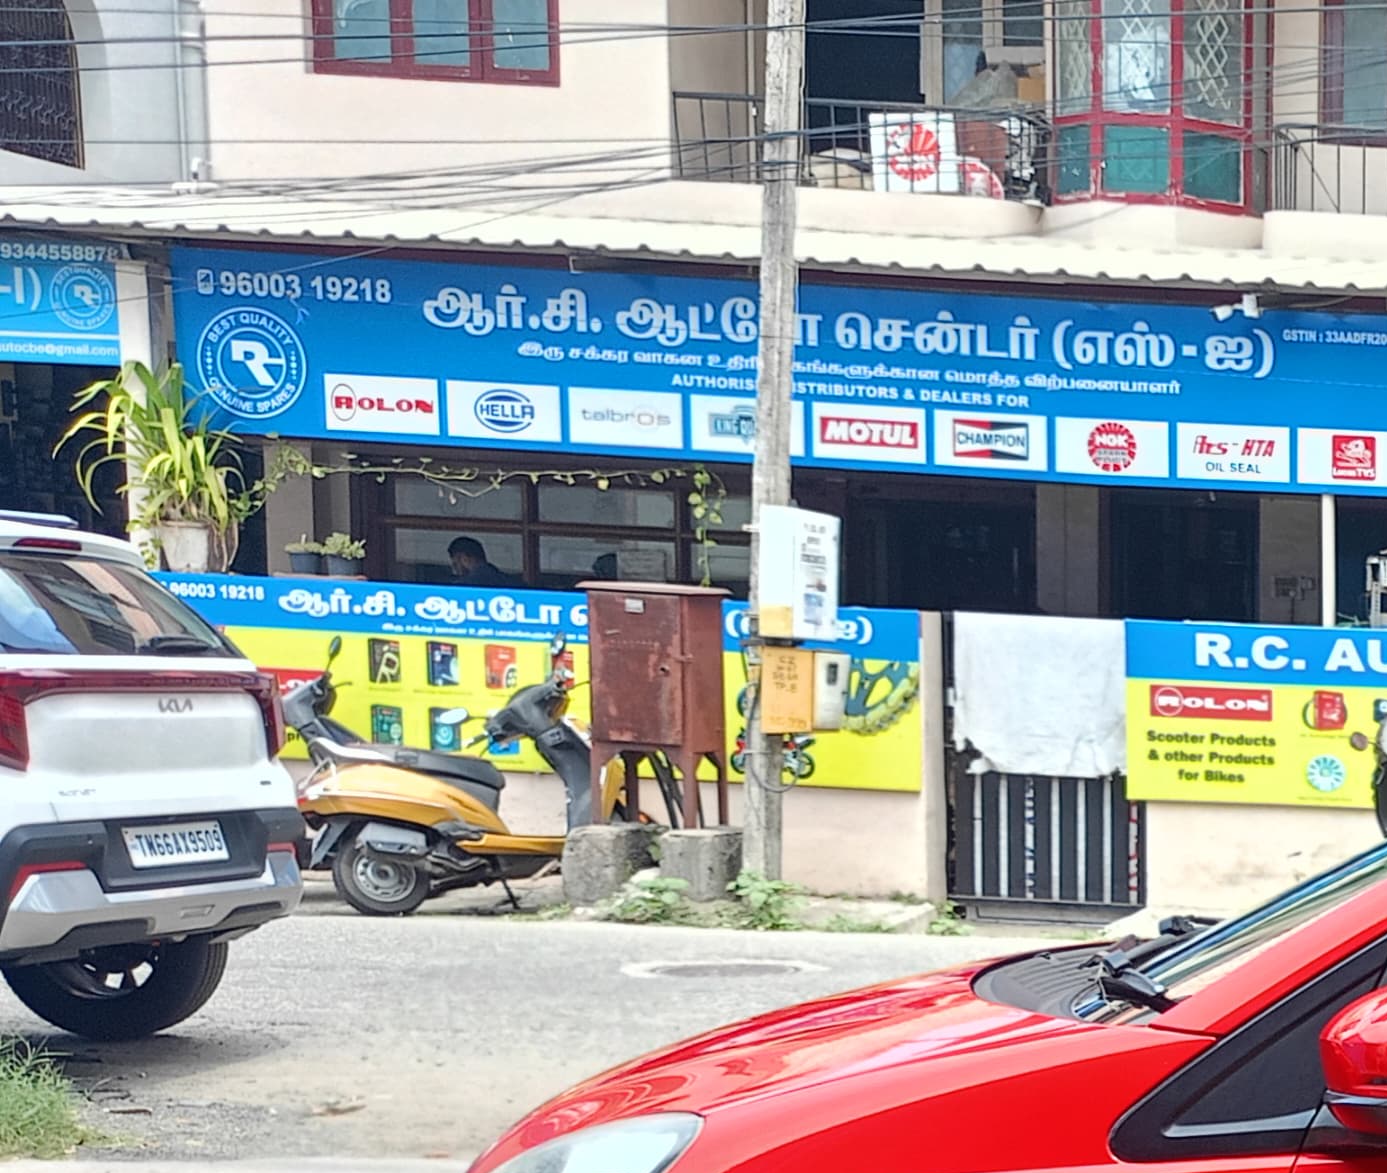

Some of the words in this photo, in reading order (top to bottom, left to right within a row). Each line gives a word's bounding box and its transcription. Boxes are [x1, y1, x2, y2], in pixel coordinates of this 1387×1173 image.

[220, 271, 302, 299] 96003
[311, 275, 392, 304] 19218
[207, 314, 237, 343] BEST
[239, 312, 293, 347] QUALITY
[423, 284, 603, 336] ஆர்.சி.
[834, 310, 1040, 361] சென்டர்
[1282, 328, 1317, 342] GSTIN
[0, 341, 119, 357] utocbe@gmail.com
[517, 341, 565, 361] இரு
[568, 345, 628, 364] சக்கர
[633, 350, 702, 367] வாகன
[210, 377, 254, 413] GENUINE
[256, 383, 296, 413] SPARES
[671, 373, 758, 392] AUTHORIS
[791, 380, 898, 400] ISTRIBUTORS
[903, 387, 916, 401] &
[919, 389, 993, 406] DEALERS
[996, 394, 1029, 409] FOR
[333, 396, 434, 415] ROLON
[479, 403, 536, 421] HELLA
[824, 420, 916, 446] MOTUL
[956, 430, 1027, 449] CHAMPION
[1095, 433, 1129, 448] NGK
[1205, 461, 1224, 472] OIL
[1229, 462, 1262, 474] SEAL
[169, 582, 216, 598] 96003
[219, 584, 265, 601] 19218
[278, 587, 406, 618] ஆர்.சி.
[414, 595, 562, 625] ஆட்டோ
[1194, 632, 1307, 671] R.C.
[1156, 694, 1269, 712] ROLON
[1147, 730, 1205, 745] Scooter
[1210, 733, 1276, 748] Products
[1148, 750, 1160, 761] &
[1164, 750, 1204, 763] other
[1209, 752, 1275, 766] Products
[1178, 769, 1200, 781] for
[1204, 770, 1245, 784] Bikes
[135, 827, 223, 856] TN66AX9509
